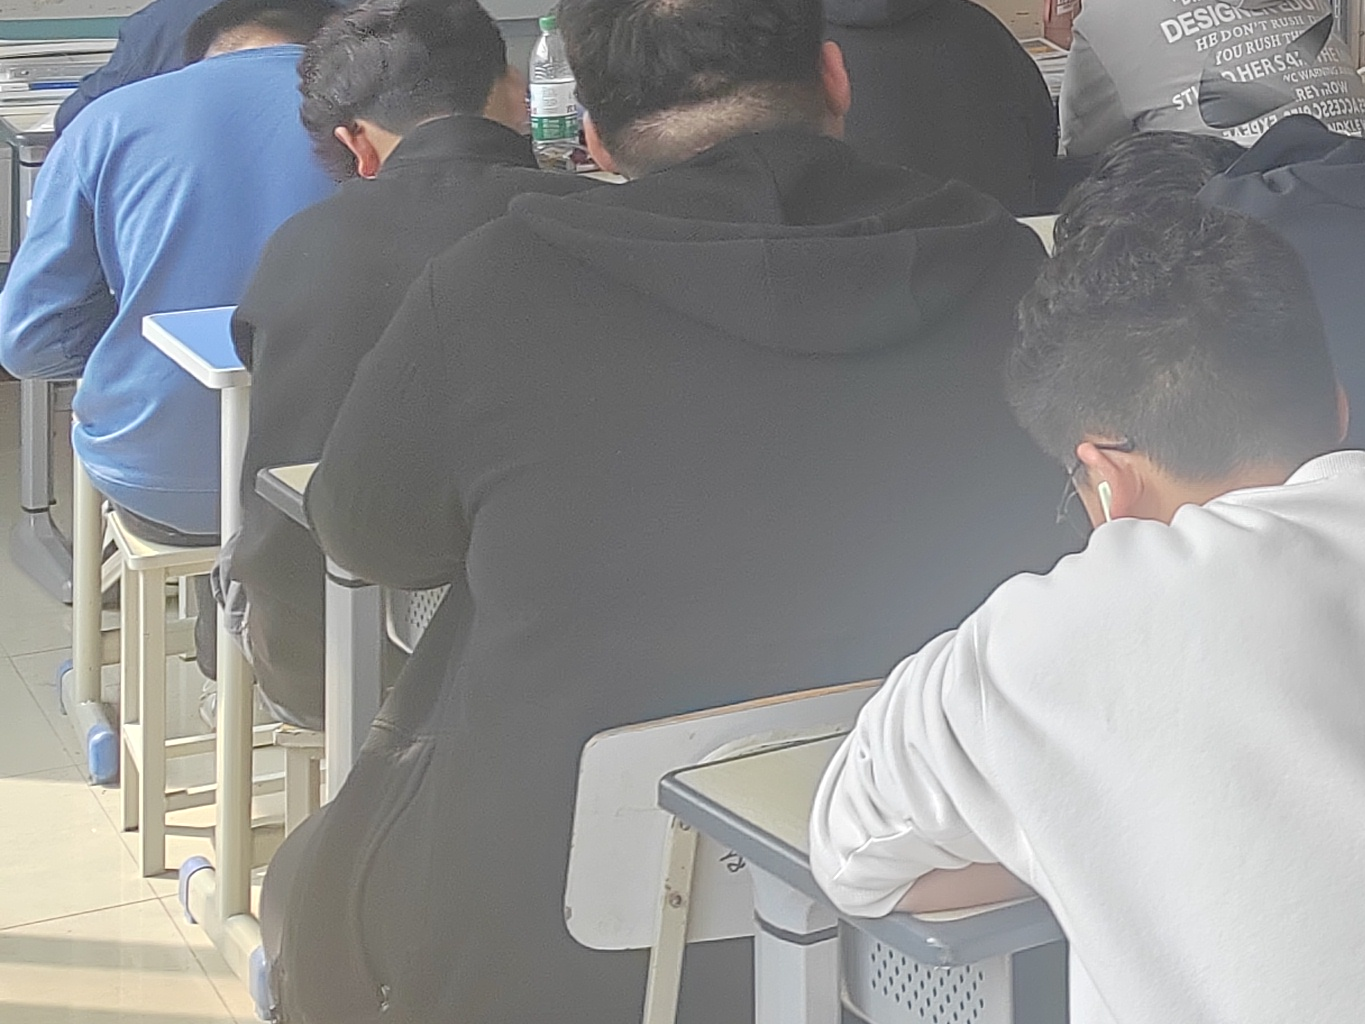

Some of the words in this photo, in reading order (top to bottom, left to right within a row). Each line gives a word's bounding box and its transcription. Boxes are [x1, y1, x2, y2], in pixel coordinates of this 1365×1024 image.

[1220, 20, 1267, 42] DON'T
[1270, 15, 1304, 30] RUSH
[1246, 34, 1279, 55] RUSH
